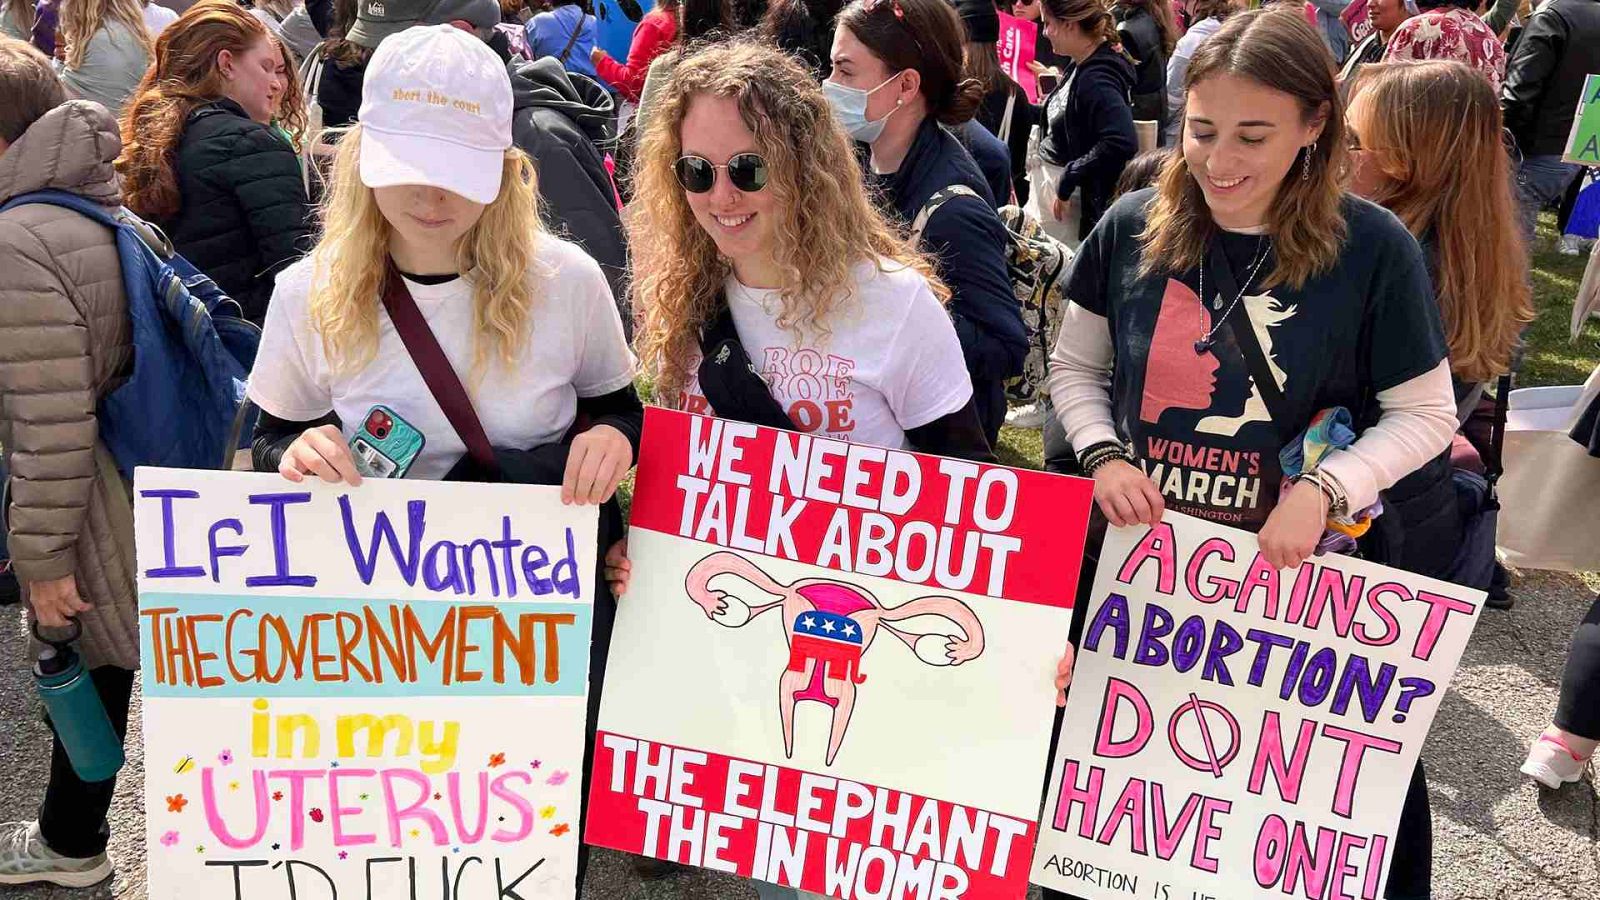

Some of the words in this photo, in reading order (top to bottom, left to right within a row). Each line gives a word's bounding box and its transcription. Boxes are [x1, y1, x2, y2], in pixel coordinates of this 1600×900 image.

[392, 86, 421, 101] abort
[426, 87, 448, 106] the
[453, 98, 481, 115] court
[787, 400, 856, 433] OE
[1147, 436, 1261, 476] WOMEN'S
[688, 415, 758, 488] WE
[768, 430, 923, 514] NEED
[938, 458, 1019, 532] TO
[245, 491, 317, 588] I
[337, 494, 581, 599] Wanted
[676, 473, 809, 560] TALK
[815, 507, 1022, 598] ABOUT
[1116, 521, 1476, 662] AGAINST
[1083, 592, 1436, 724] ABORTION?
[250, 698, 320, 759] in
[336, 712, 461, 775] my
[201, 767, 535, 851] UTERUS
[602, 734, 708, 808] THE
[723, 759, 1028, 878] ELEPHANT
[637, 798, 744, 874] THE
[750, 823, 808, 889] IN
[1051, 759, 1233, 874] HAVE
[1043, 854, 1138, 894] ABORTION
[1154, 881, 1171, 900] IS
